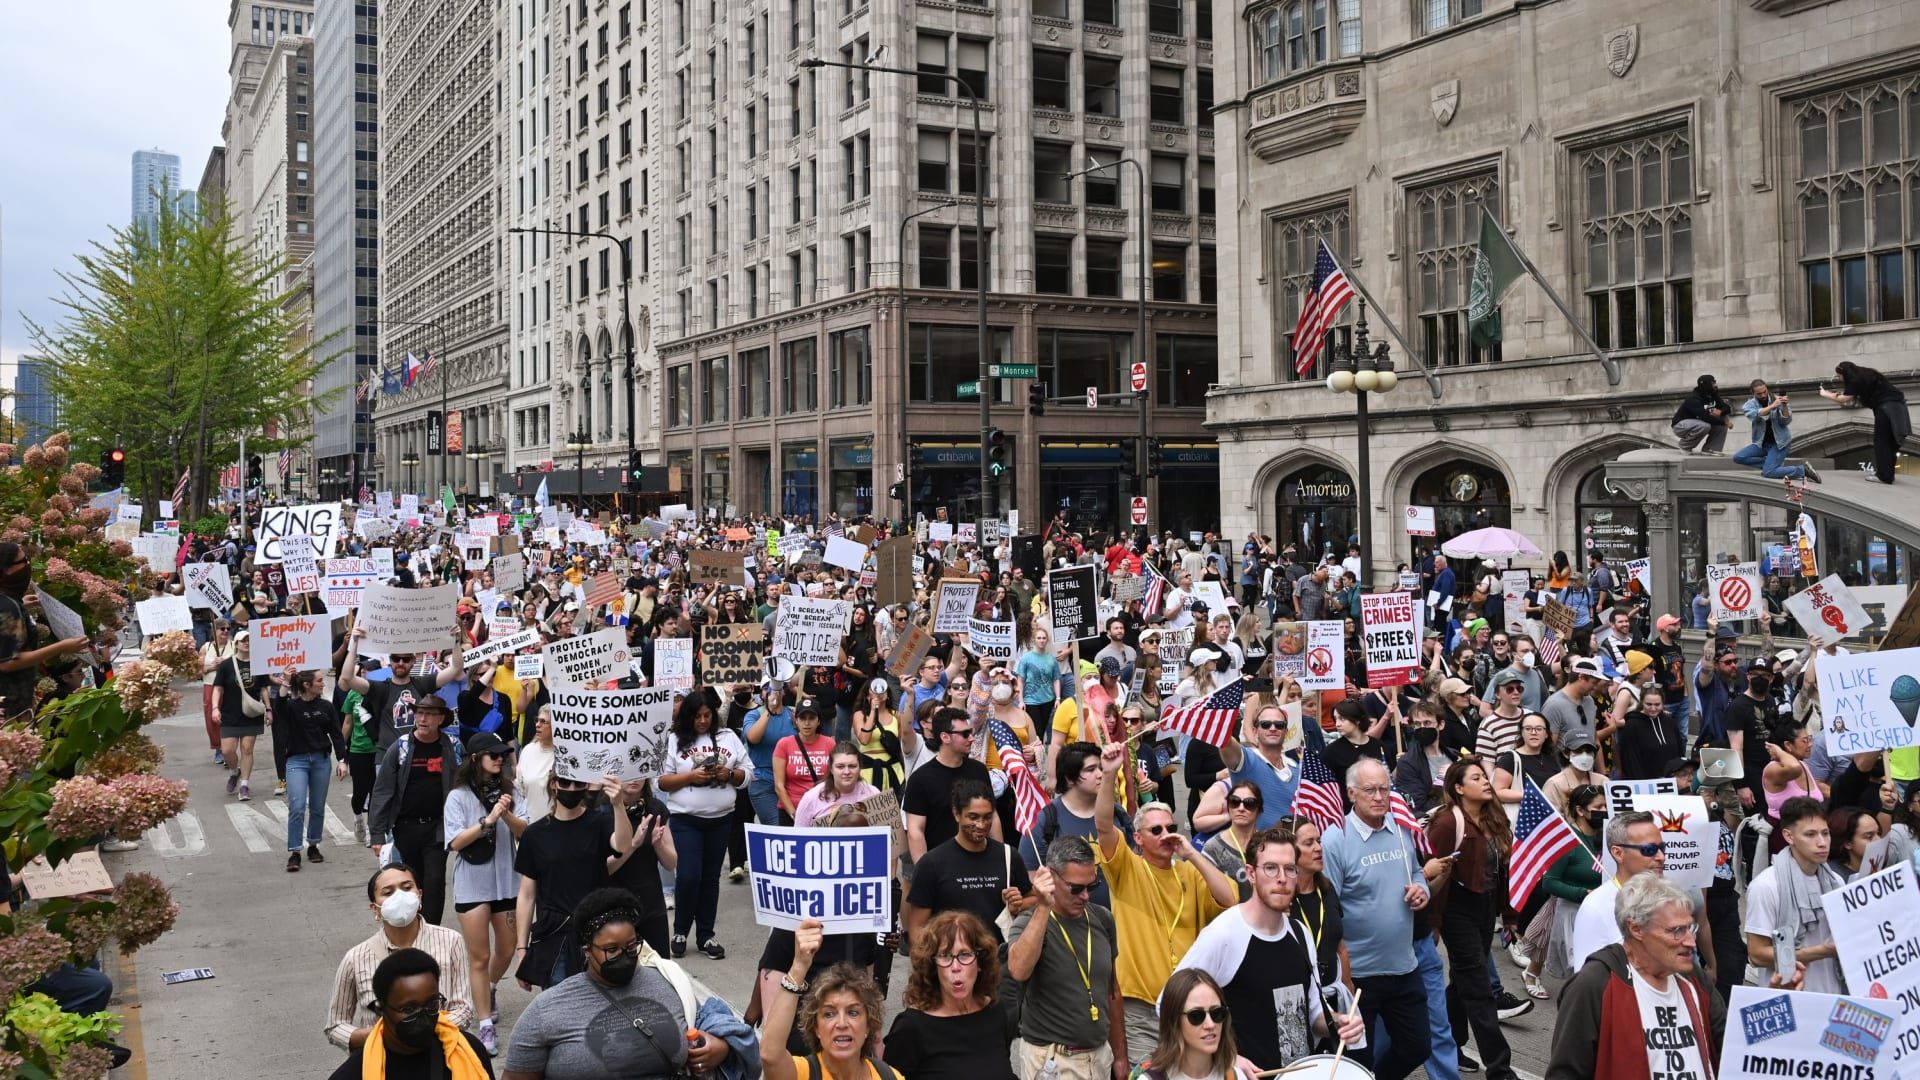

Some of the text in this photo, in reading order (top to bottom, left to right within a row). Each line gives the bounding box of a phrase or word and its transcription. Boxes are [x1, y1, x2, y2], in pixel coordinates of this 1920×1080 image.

[1003, 366, 1029, 374] Monroe
[938, 452, 974, 462] citibank
[1178, 452, 1210, 462] citibank
[1294, 478, 1350, 498] Amorino
[261, 510, 332, 540] KING
[284, 557, 313, 565] MATTERS
[532, 552, 544, 561] NO
[188, 568, 199, 580] NO
[286, 564, 314, 574] THAT HE
[328, 560, 360, 572] SIN
[700, 566, 728, 578] ICE
[1708, 566, 1730, 582] REJECT
[288, 574, 320, 592] LIES!
[944, 586, 976, 596] PROTEST
[1053, 580, 1080, 591] THE FALL
[328, 590, 361, 606] HIEL
[946, 600, 968, 612] NOW
[1054, 597, 1078, 608] TRUMP
[1363, 596, 1410, 608] STOP POLICE
[798, 606, 825, 614] SCREAM
[1055, 606, 1082, 618] FASCIST
[1364, 606, 1412, 626] CRIMES
[968, 618, 1011, 634] HANDS OFF
[1056, 615, 1083, 626] REGIME
[260, 618, 316, 640] Empathy
[368, 625, 402, 636] PAPERS
[704, 626, 731, 640] NO
[276, 638, 300, 650] isn't
[550, 638, 594, 655] PROTECT
[656, 640, 672, 650] ICE
[784, 632, 832, 652] NOT ICE
[1374, 630, 1405, 648] FREE
[464, 651, 480, 662] CAGO
[481, 642, 501, 656] WON'T
[511, 634, 532, 646] SILENT
[702, 640, 763, 656] CROWN
[972, 640, 1011, 658] CHICAGO
[1368, 648, 1416, 664] THEM ALL
[267, 652, 306, 667] radical
[709, 654, 759, 668] FOR A
[789, 652, 808, 662] OUR
[809, 654, 834, 662] streets
[702, 668, 763, 684] CLOWN
[1841, 667, 1880, 690] LIKE
[560, 694, 596, 709] LOVE
[601, 690, 670, 708] SOMEONE
[1836, 694, 1866, 714] MY
[552, 710, 648, 726] WHO HAD AN
[1854, 712, 1878, 729] ICE
[553, 728, 628, 744] ABORTION
[1838, 726, 1914, 751] CRUSHED
[788, 756, 803, 764] I'M
[764, 838, 864, 876] ICE OUT!
[1664, 852, 1700, 860] TRUMP
[1664, 863, 1700, 871] EOVER.
[1842, 868, 1904, 912] NO ONE
[834, 882, 882, 916] ICE!
[1878, 920, 1896, 945] IS
[1655, 1006, 1678, 1028] BE
[1746, 1002, 1788, 1024] ABOLISH
[1831, 1000, 1889, 1042] CHINGA
[1849, 1028, 1861, 1040] LA
[1824, 1030, 1876, 1063] MIGRA
[1666, 1050, 1685, 1072] TO
[1742, 1055, 1875, 1080] IMMIGRANTS
